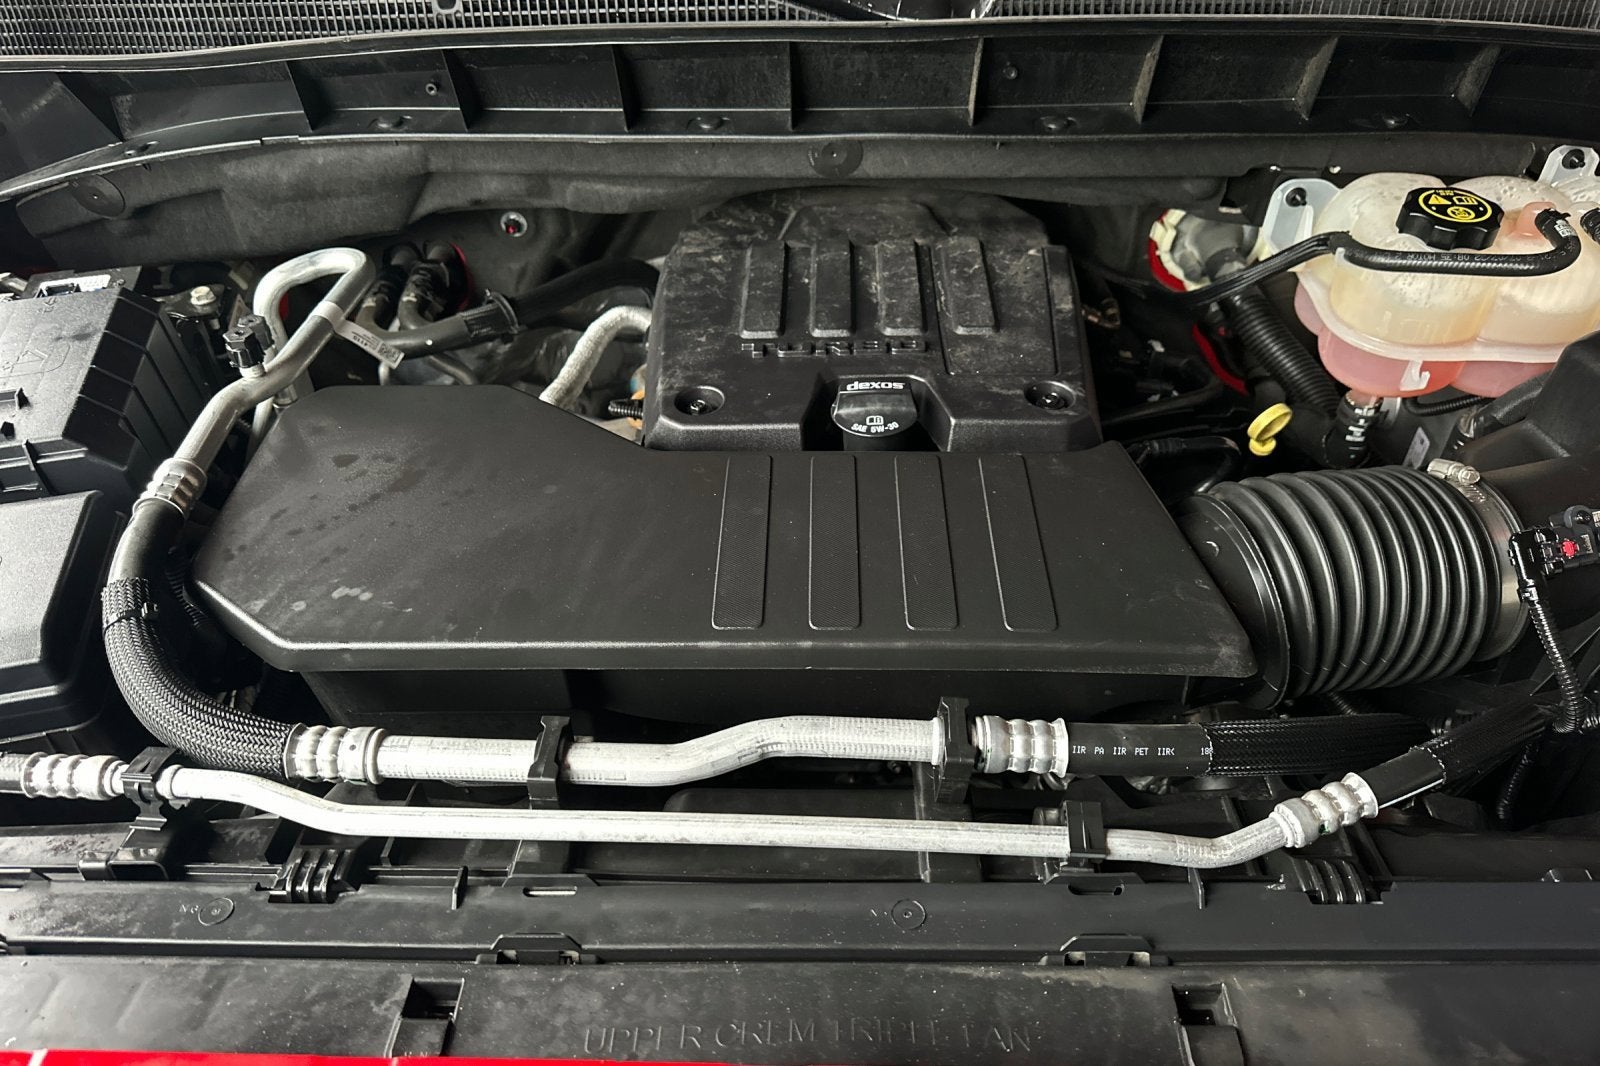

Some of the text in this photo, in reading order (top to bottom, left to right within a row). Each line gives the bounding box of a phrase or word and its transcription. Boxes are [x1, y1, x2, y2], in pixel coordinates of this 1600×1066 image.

[846, 380, 906, 391] dexos
[850, 421, 900, 434] SAE 5W-30
[1093, 746, 1105, 755] PA
[1134, 747, 1149, 756] PET
